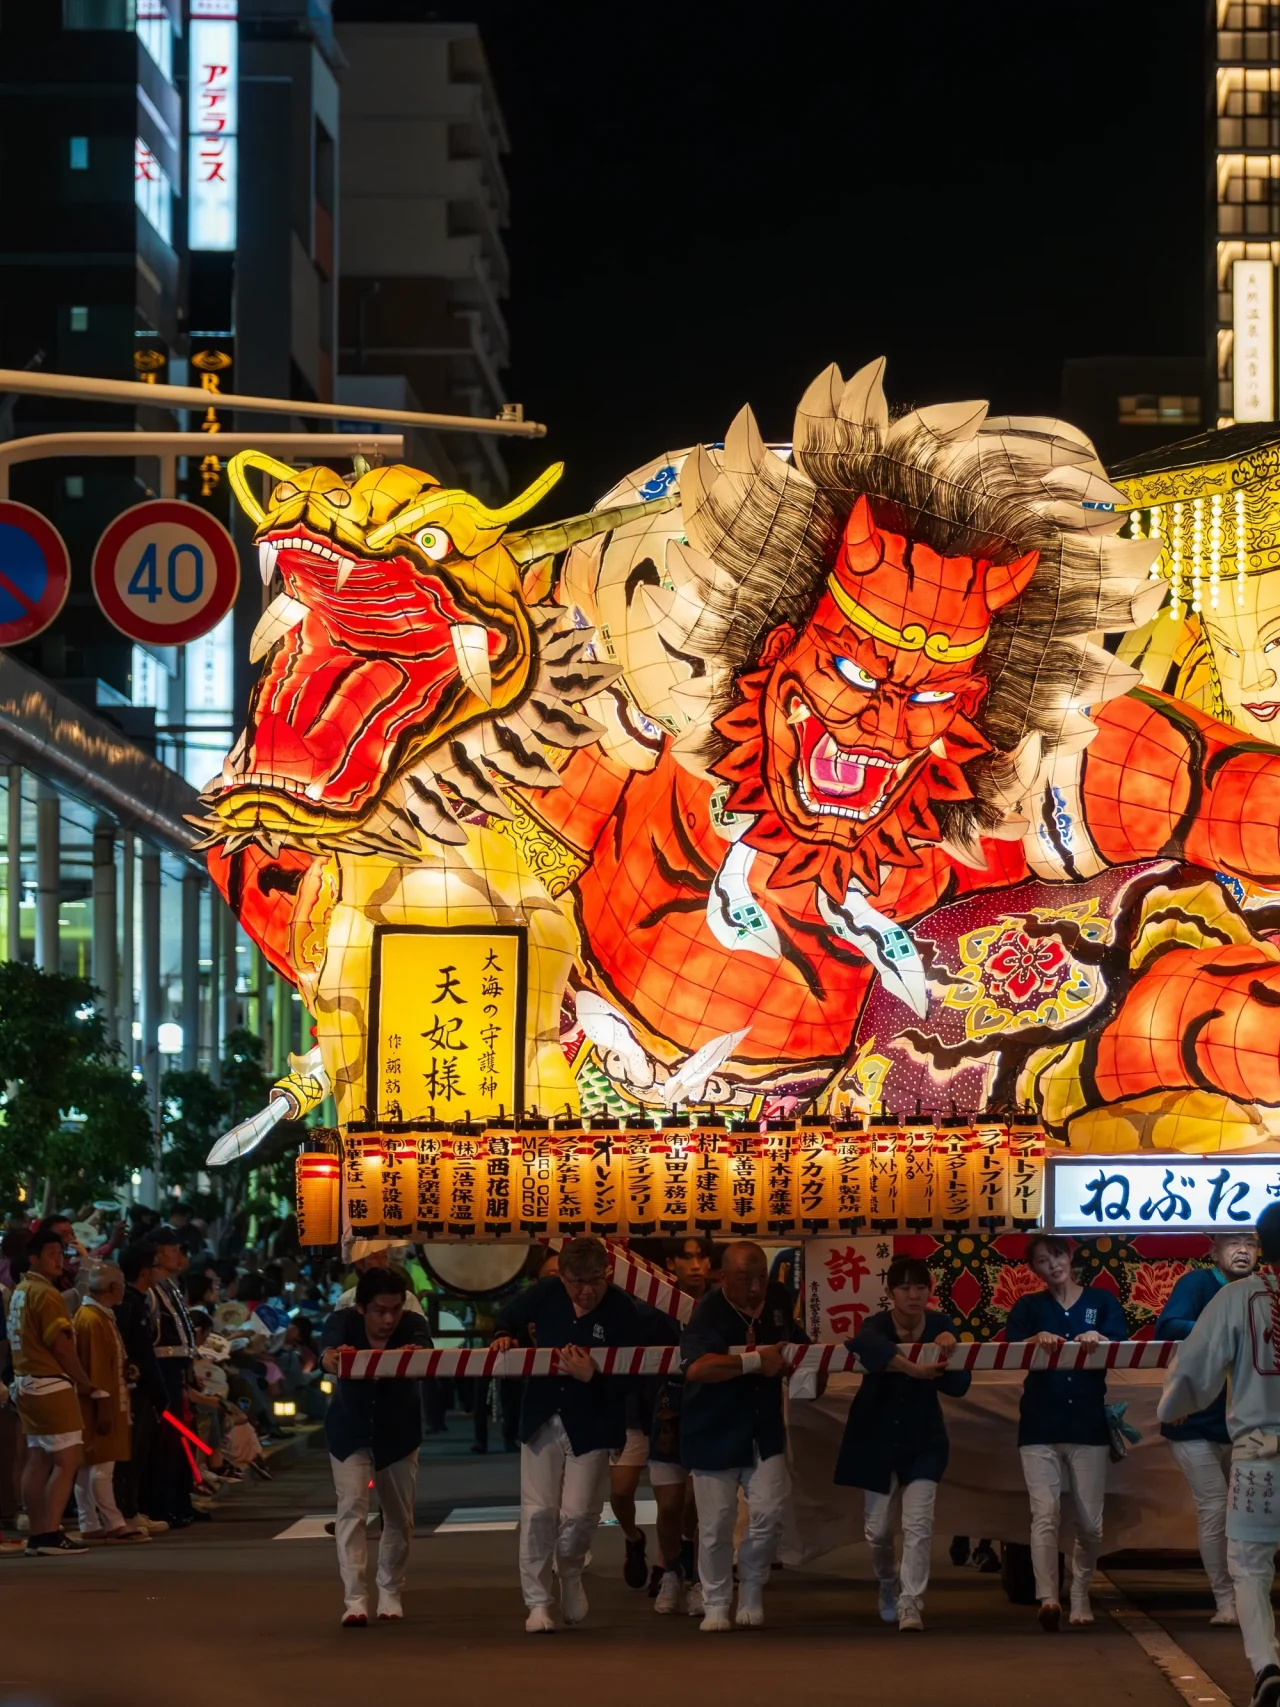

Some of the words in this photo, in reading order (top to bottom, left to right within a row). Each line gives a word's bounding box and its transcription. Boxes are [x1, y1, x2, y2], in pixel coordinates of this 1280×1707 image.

[198, 64, 228, 182] アデランス
[127, 543, 204, 604] 40
[420, 965, 469, 1102] 天妃様
[477, 948, 505, 1100] 大海の守護神
[382, 1139, 405, 1220] (有)小野設備
[450, 1140, 478, 1220] (株)三浩保温
[486, 1137, 510, 1218] 葛西花朋
[522, 1136, 536, 1217] MOTORS
[538, 1136, 550, 1180] ZERO
[557, 1136, 581, 1217] スマホなおし太郎
[591, 1135, 615, 1216] オレンジ
[627, 1134, 654, 1215] 芳賀ライブラリー
[663, 1133, 690, 1215] (有)山田工務店
[696, 1133, 720, 1213] 村上建装
[732, 1138, 756, 1217] 正善商事
[768, 1136, 793, 1215] 川村木材産業
[800, 1132, 826, 1211] (株)フカガワ
[888, 1132, 898, 1213] ライトブルー
[905, 1132, 915, 1180] うるる
[924, 1132, 933, 1212] ライトブルー
[945, 1134, 970, 1214] AIスタートアップ
[979, 1129, 1003, 1211] ライトブルー
[1014, 1132, 1038, 1214] ライトブルー
[537, 1185, 550, 1217] ONE
[824, 1246, 870, 1341] 許可
[876, 1243, 891, 1311] 第十号
